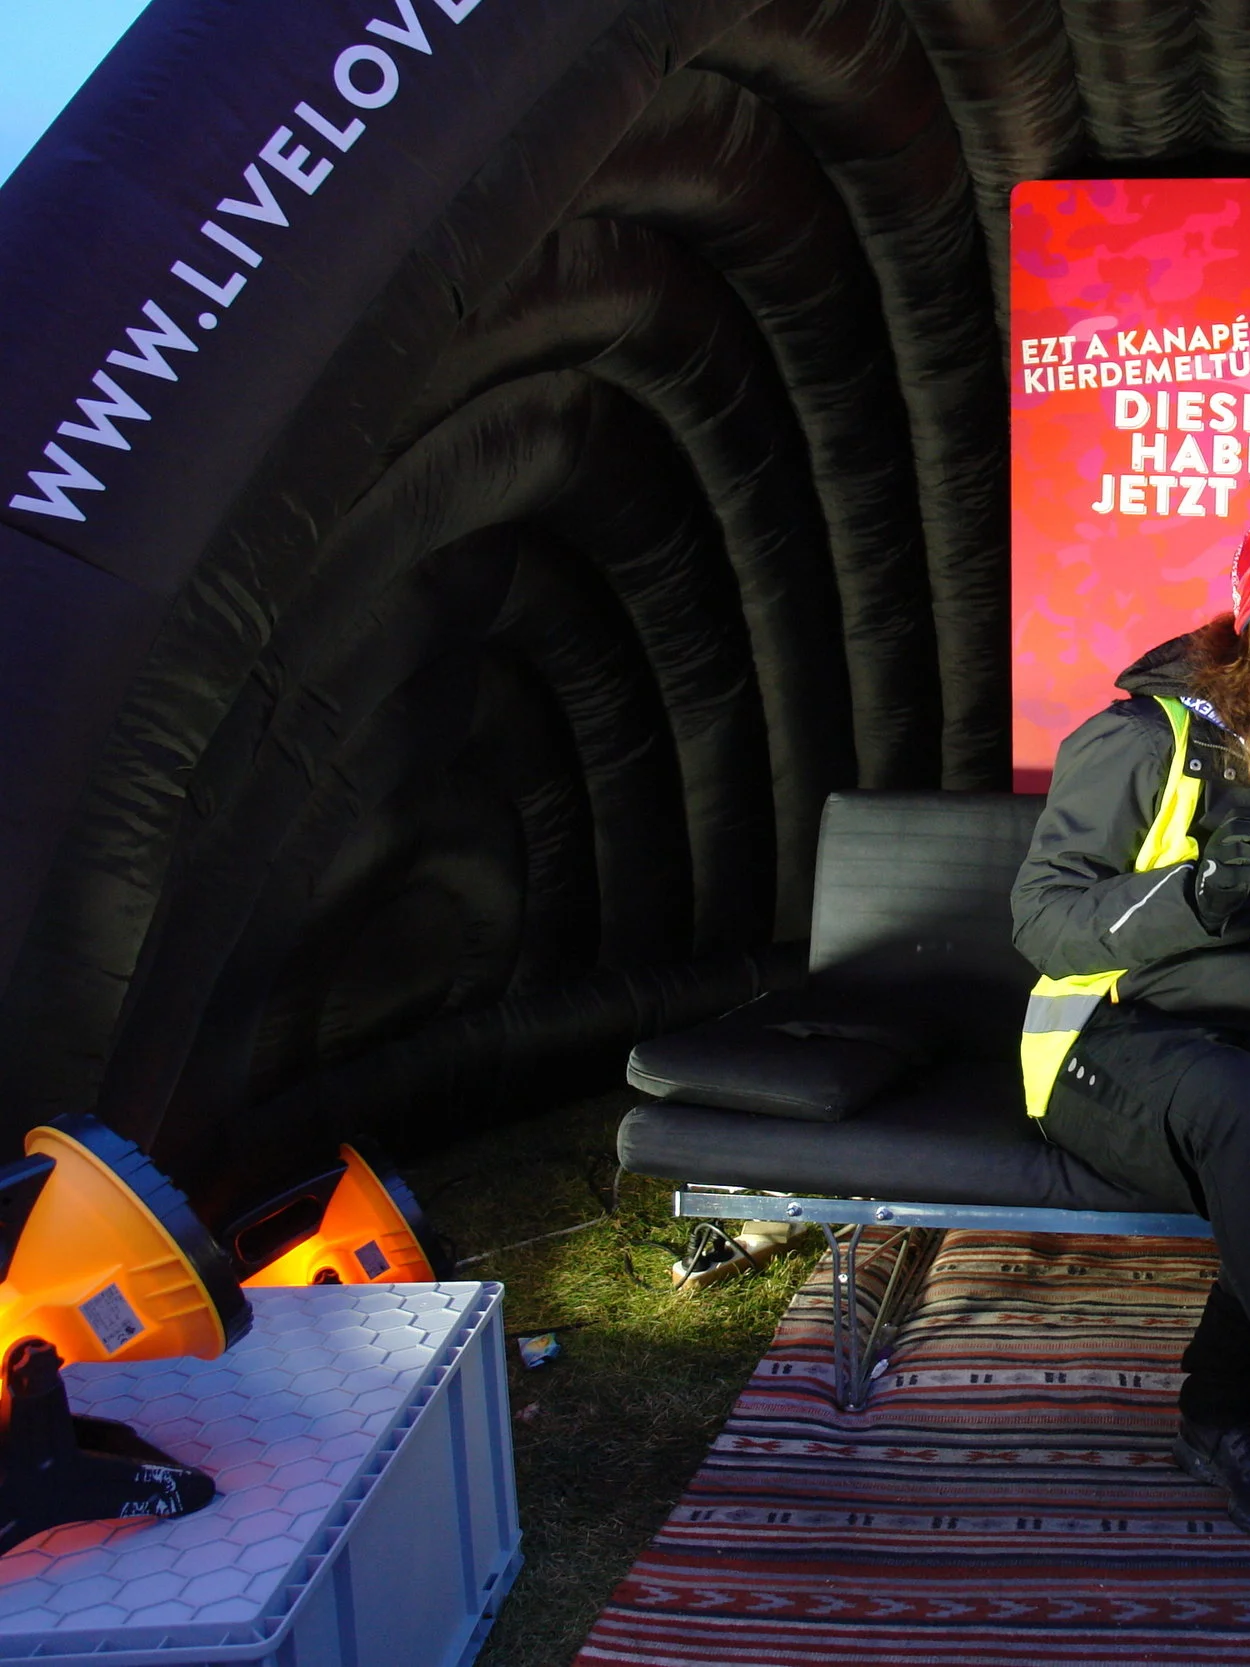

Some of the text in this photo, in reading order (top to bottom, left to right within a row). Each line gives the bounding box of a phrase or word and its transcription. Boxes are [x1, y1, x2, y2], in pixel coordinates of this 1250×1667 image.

[1021, 335, 1076, 366] EZT
[1085, 337, 1109, 360] A
[1091, 473, 1237, 517] JETZT
